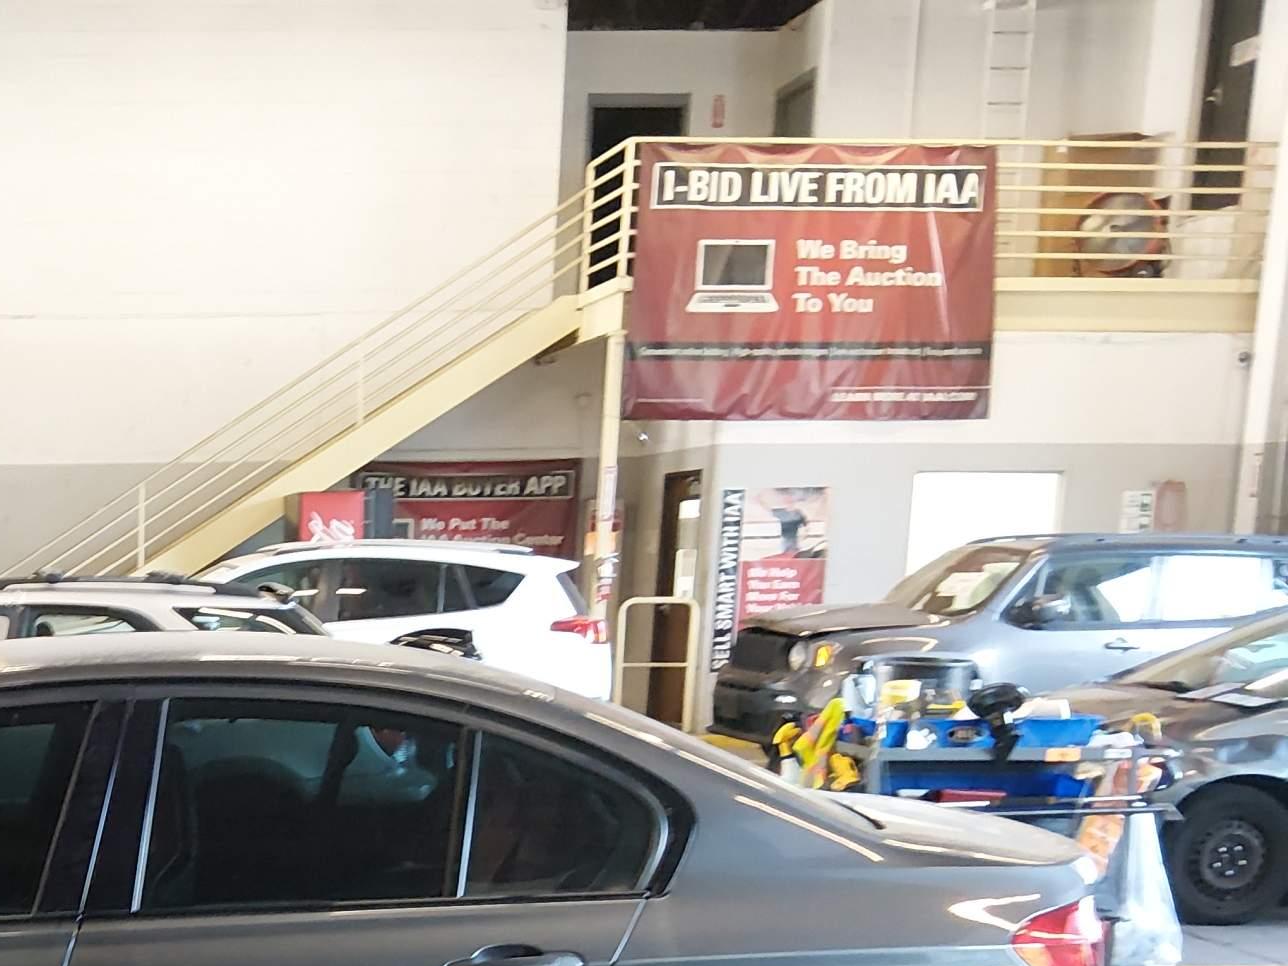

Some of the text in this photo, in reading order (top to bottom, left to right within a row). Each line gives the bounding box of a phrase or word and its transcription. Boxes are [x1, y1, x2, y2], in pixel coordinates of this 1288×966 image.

[663, 170, 979, 205] I-BID LIVE FROM IAA
[796, 239, 907, 264] We Bring
[794, 266, 943, 286] The Auction
[791, 292, 874, 312] To You
[524, 475, 566, 496] APP
[723, 493, 744, 522] IAA
[719, 526, 739, 570] WITH
[715, 572, 736, 630] SMART
